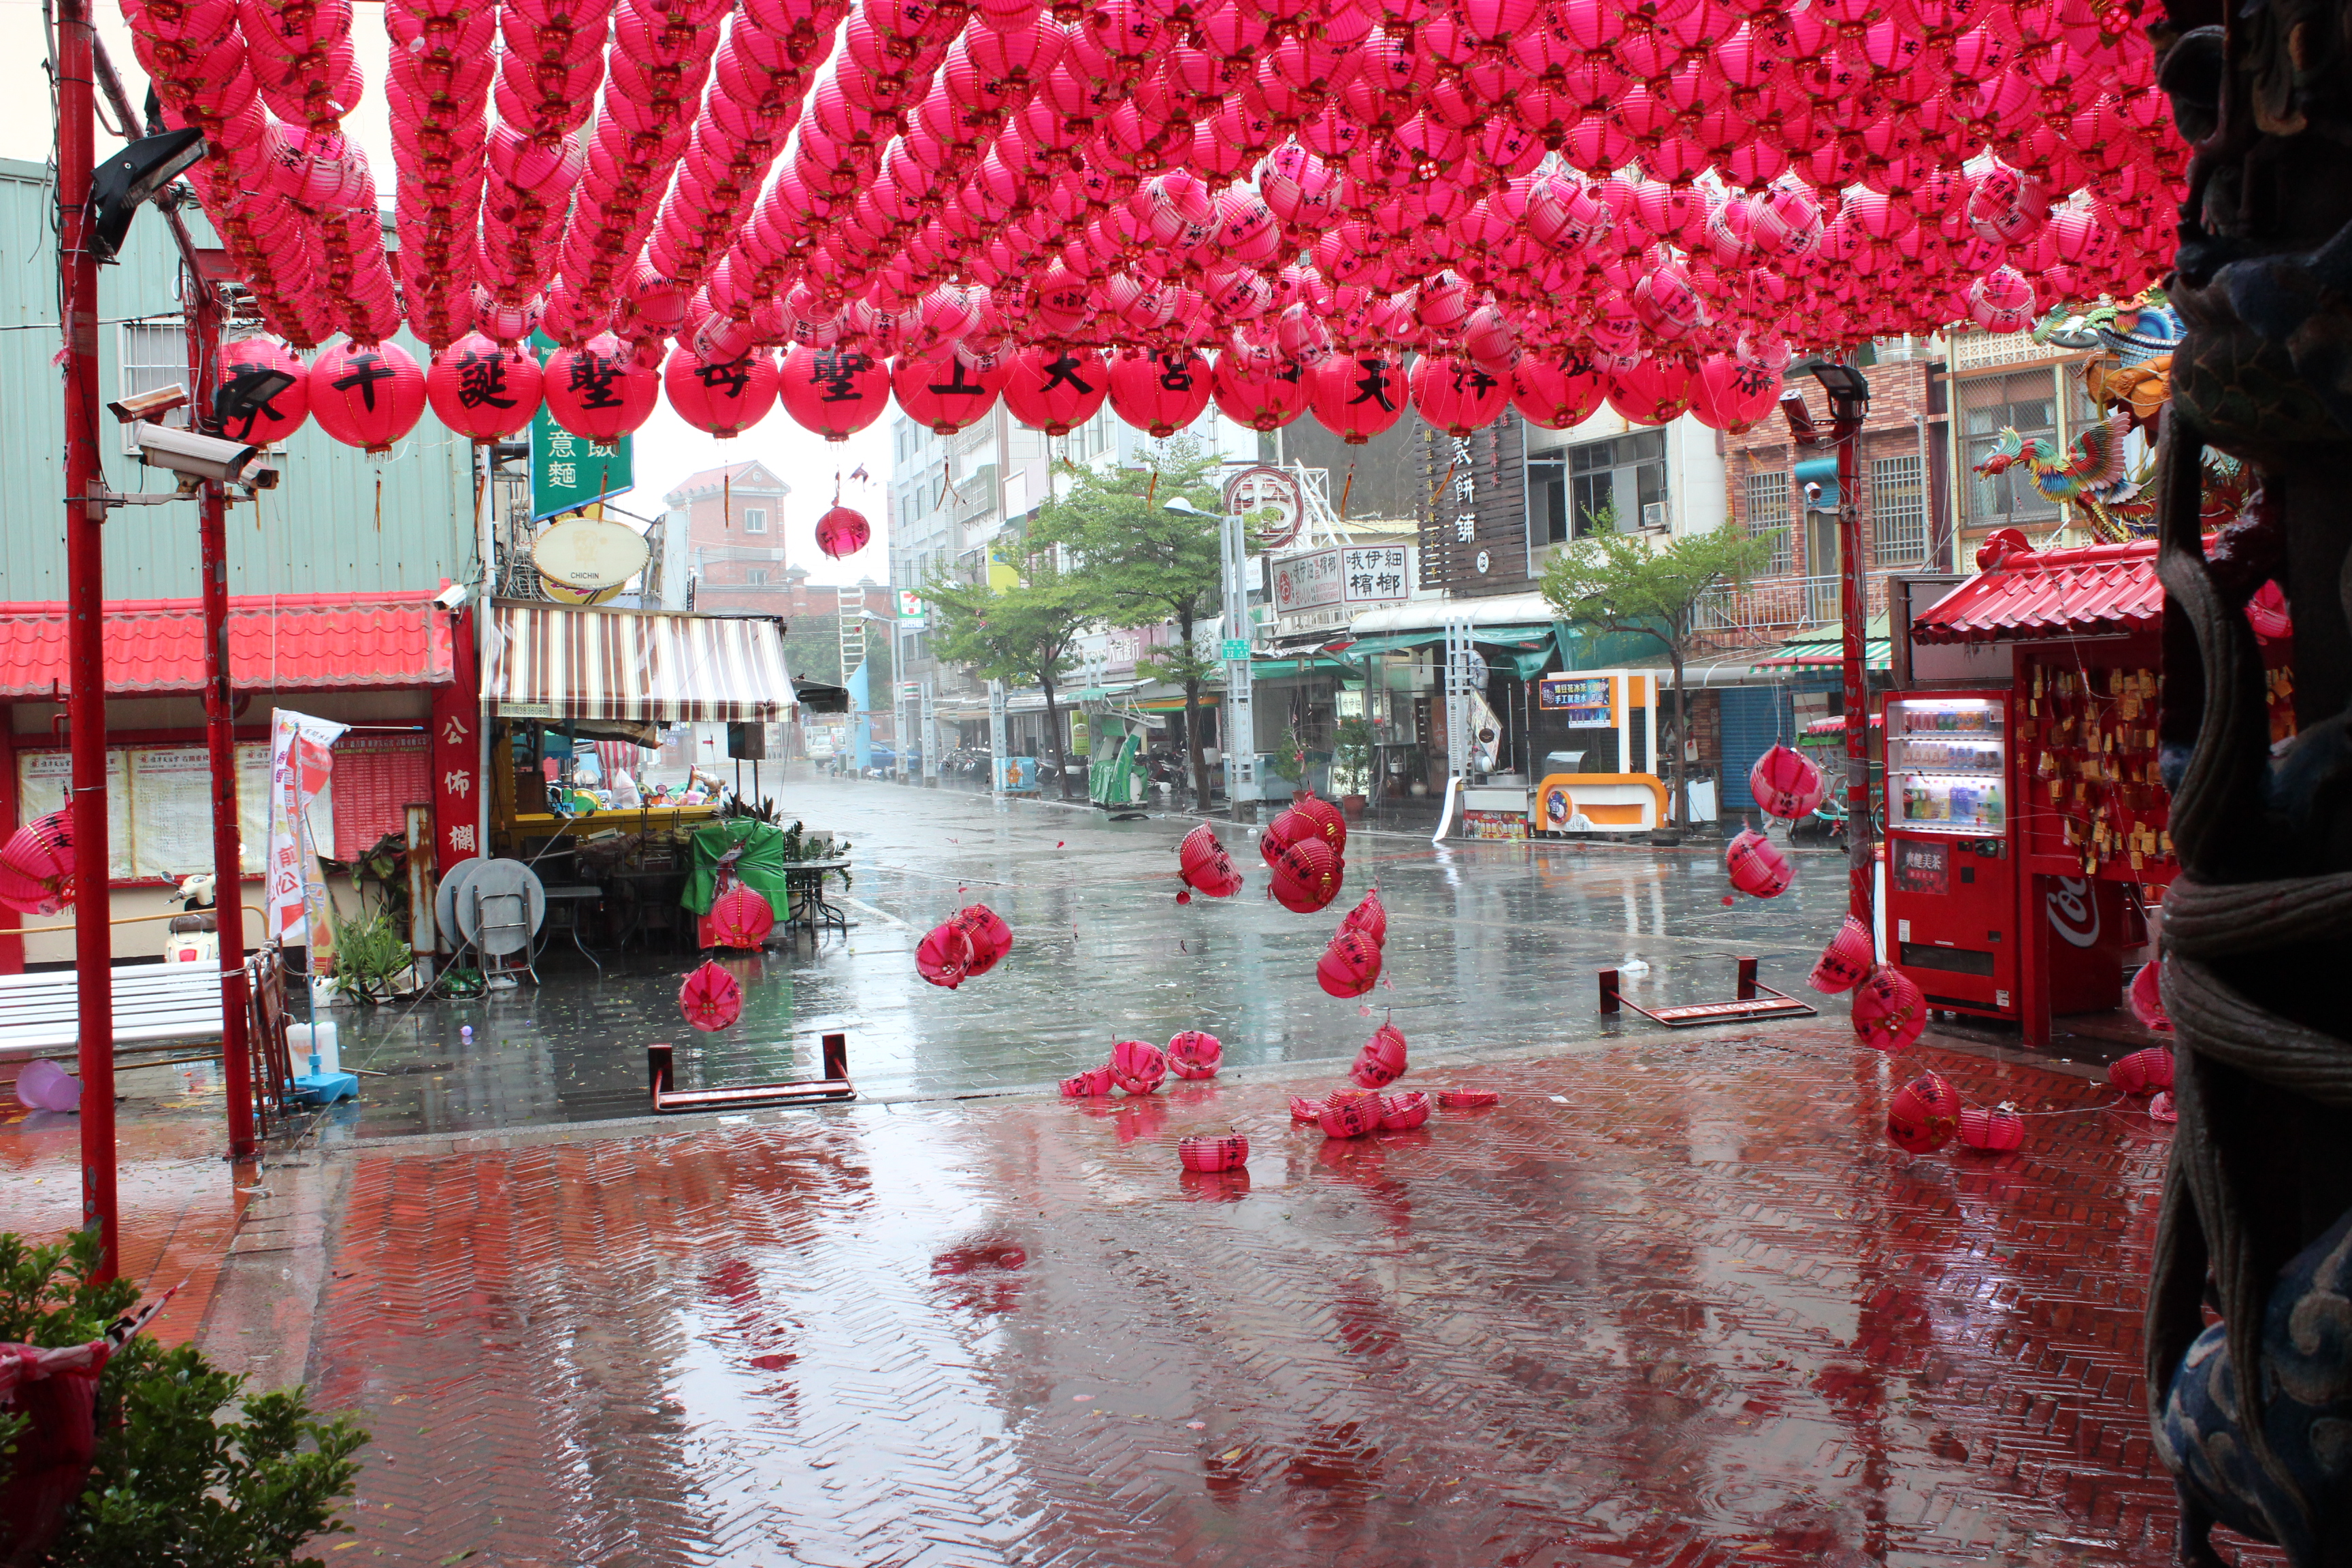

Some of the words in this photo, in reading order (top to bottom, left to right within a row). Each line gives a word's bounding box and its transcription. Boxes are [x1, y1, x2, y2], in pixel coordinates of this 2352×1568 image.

[1346, 549, 1403, 570] 哦伊細
[1350, 572, 1401, 598] 檳榔
[1554, 694, 1586, 704] 手工氣泡水
[442, 715, 476, 853] 公佈欄
[1906, 851, 1942, 870] 爽健美茶
